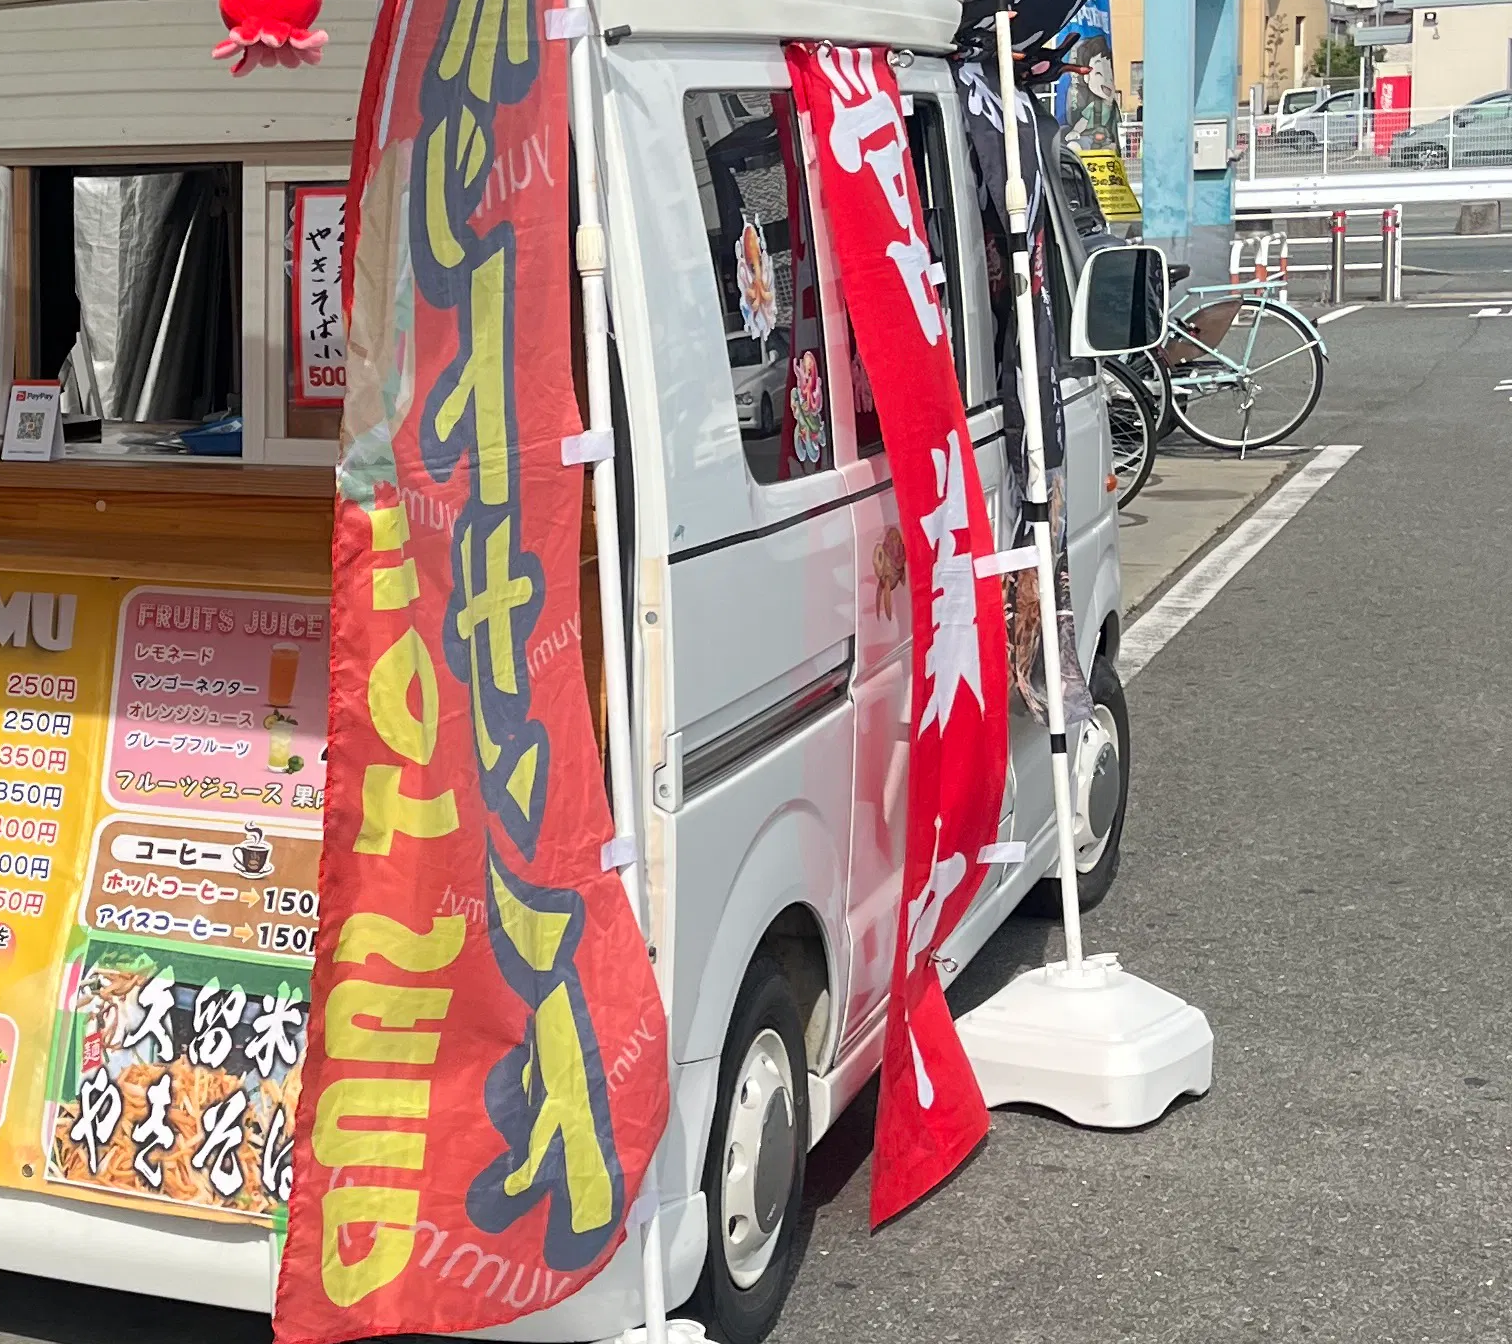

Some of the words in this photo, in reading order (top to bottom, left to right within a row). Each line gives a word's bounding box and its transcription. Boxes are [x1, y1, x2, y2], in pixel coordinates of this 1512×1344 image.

[308, 365, 347, 387] 500
[26, 392, 54, 401] PayPay
[137, 603, 235, 633] FRUITS
[243, 608, 325, 639] JUICE
[135, 643, 214, 665] レモネード
[7, 674, 77, 700] 250円
[132, 673, 258, 696] マンゴーネクター
[3, 710, 72, 736] 250円
[128, 702, 254, 727] オレンジジュース
[115, 770, 284, 805] フルーツジュース
[134, 841, 223, 866] コーヒー
[105, 872, 238, 902] ホットコーヒー
[263, 889, 320, 916] 150
[99, 907, 231, 937] アイスコーヒー
[258, 925, 318, 953] 150
[122, 964, 304, 1078] 久留米
